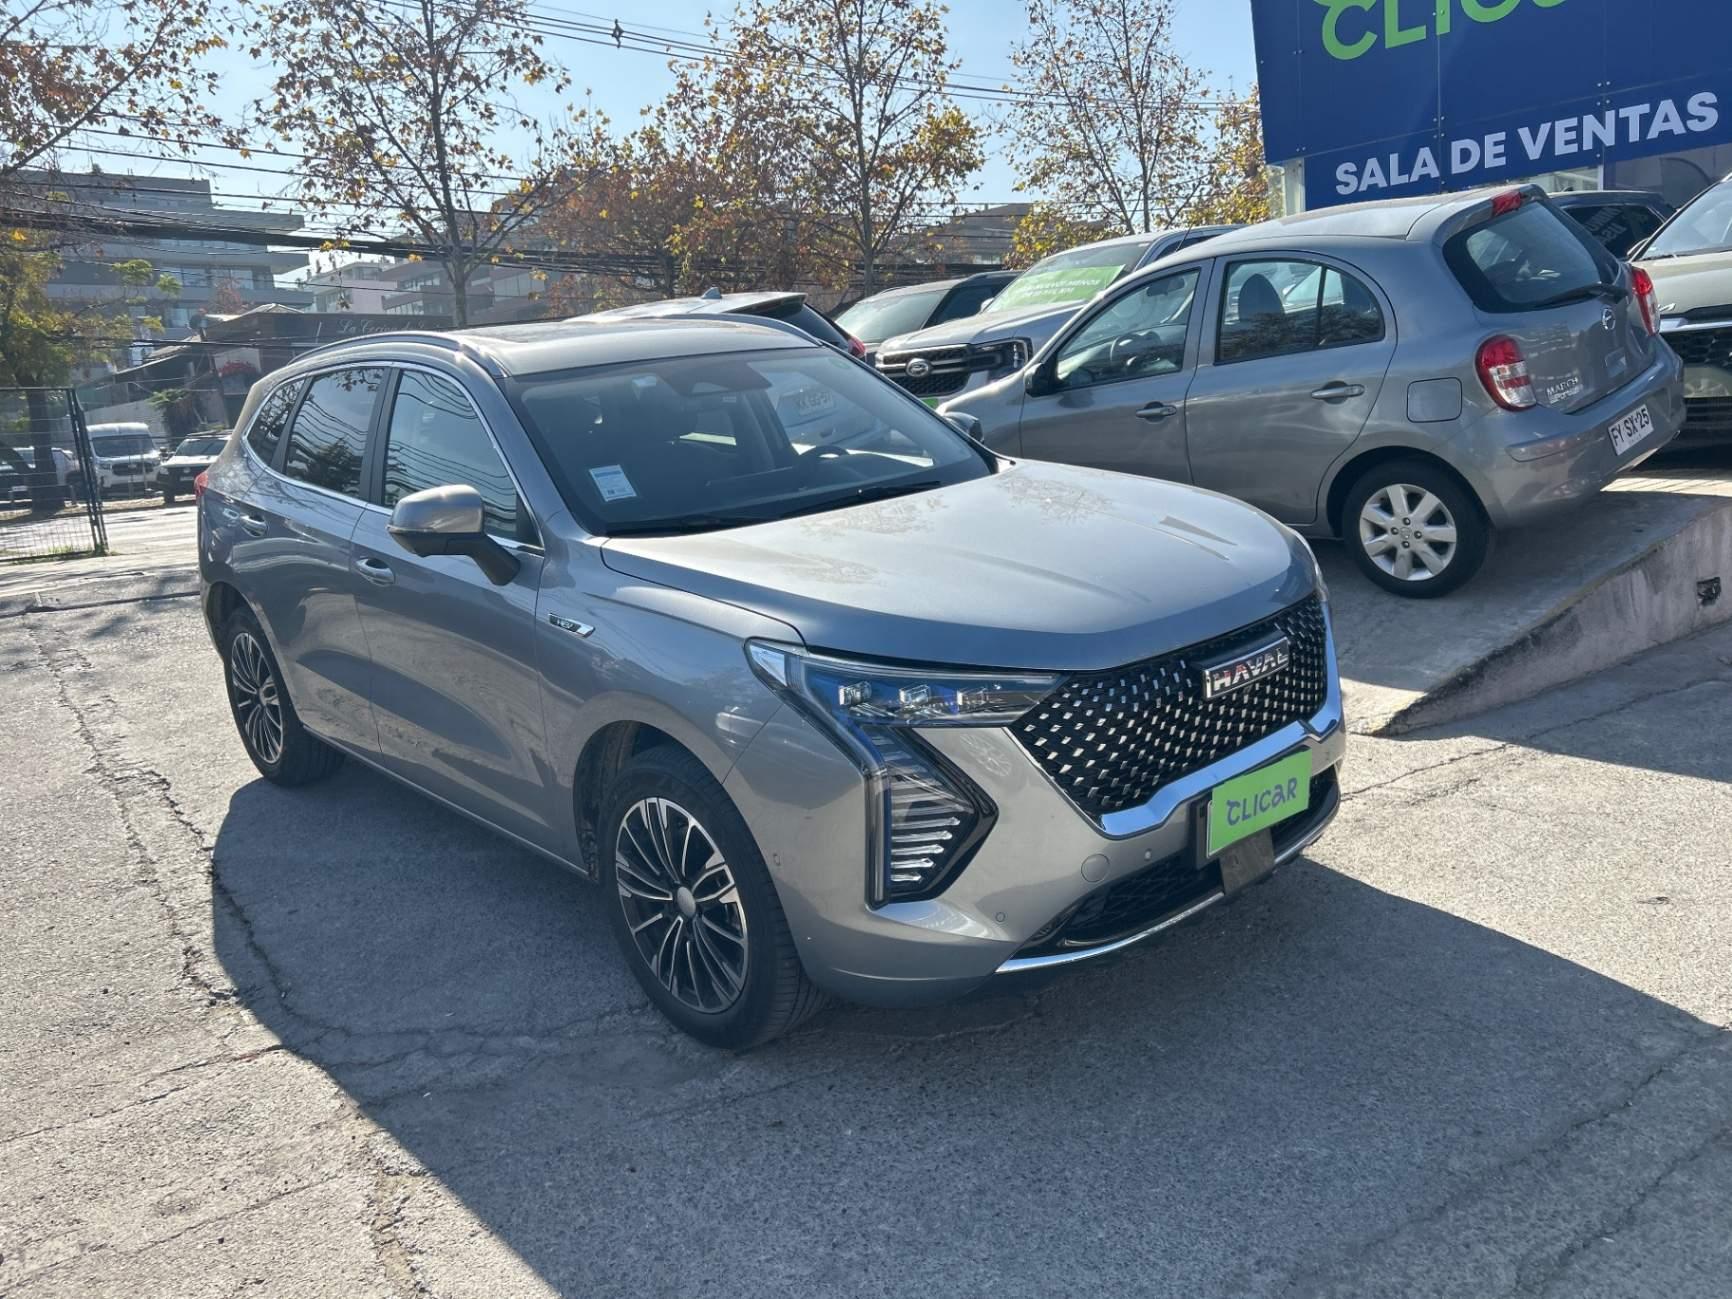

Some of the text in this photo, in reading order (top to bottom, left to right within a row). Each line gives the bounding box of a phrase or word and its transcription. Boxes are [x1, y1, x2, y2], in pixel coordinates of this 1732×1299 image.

[1335, 92, 1719, 195] SALA DE VENTAS
[1213, 648, 1289, 691] HAVAL
